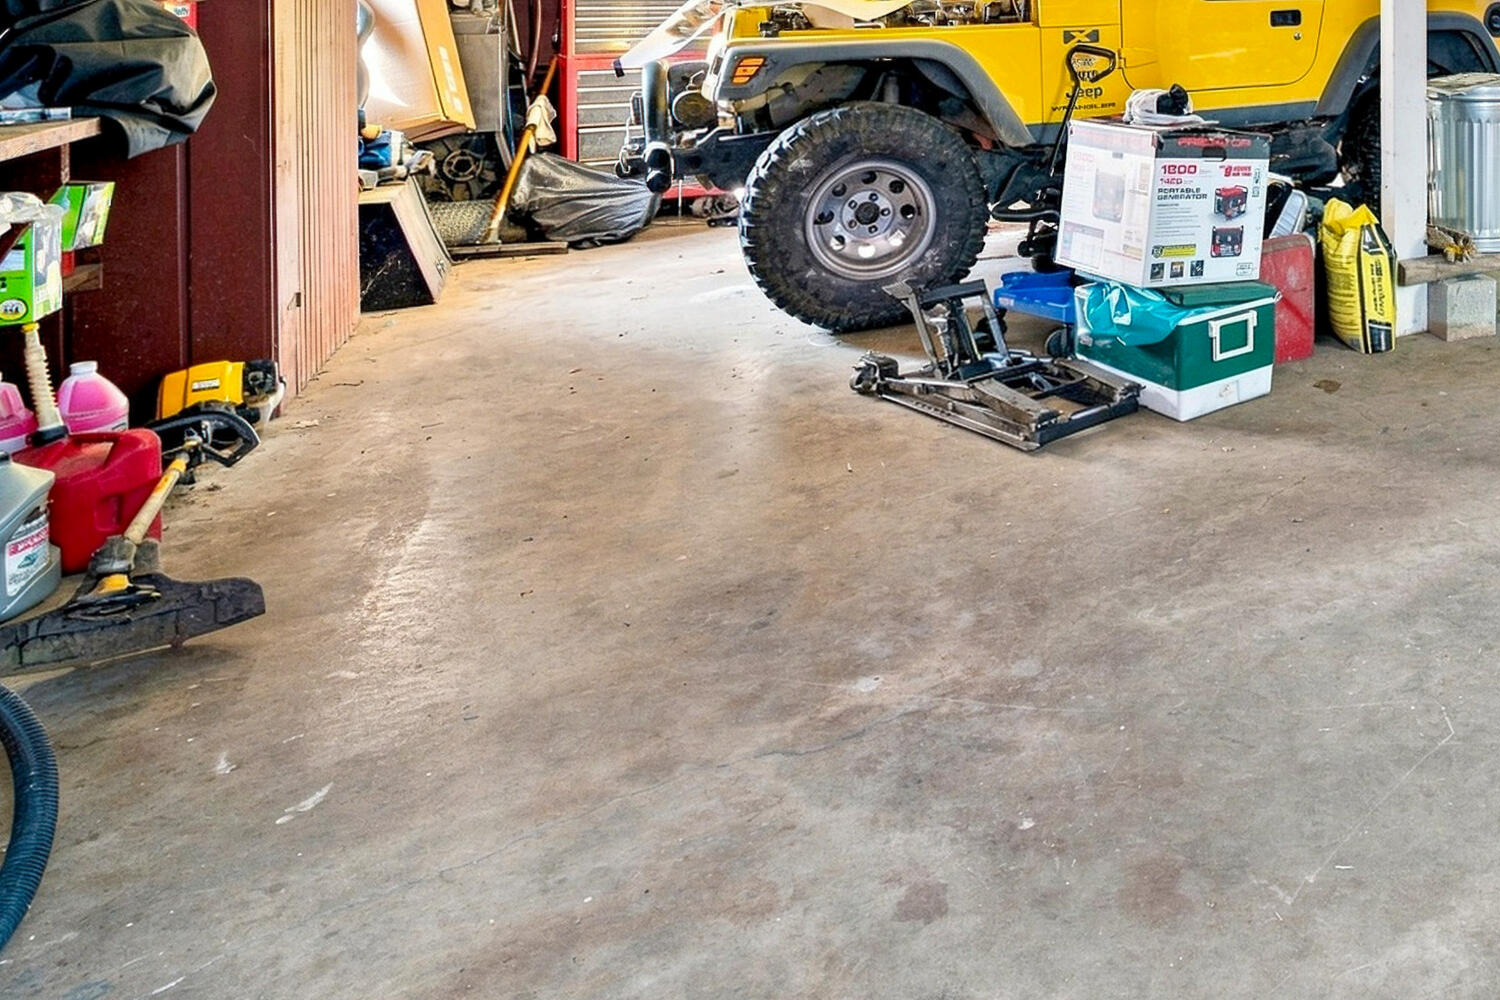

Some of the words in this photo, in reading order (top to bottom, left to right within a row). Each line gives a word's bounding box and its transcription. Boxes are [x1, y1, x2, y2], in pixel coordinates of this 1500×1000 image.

[1065, 86, 1103, 99] Jeep
[1160, 164, 1198, 175] 1800
[1157, 193, 1208, 201] GENERATOR
